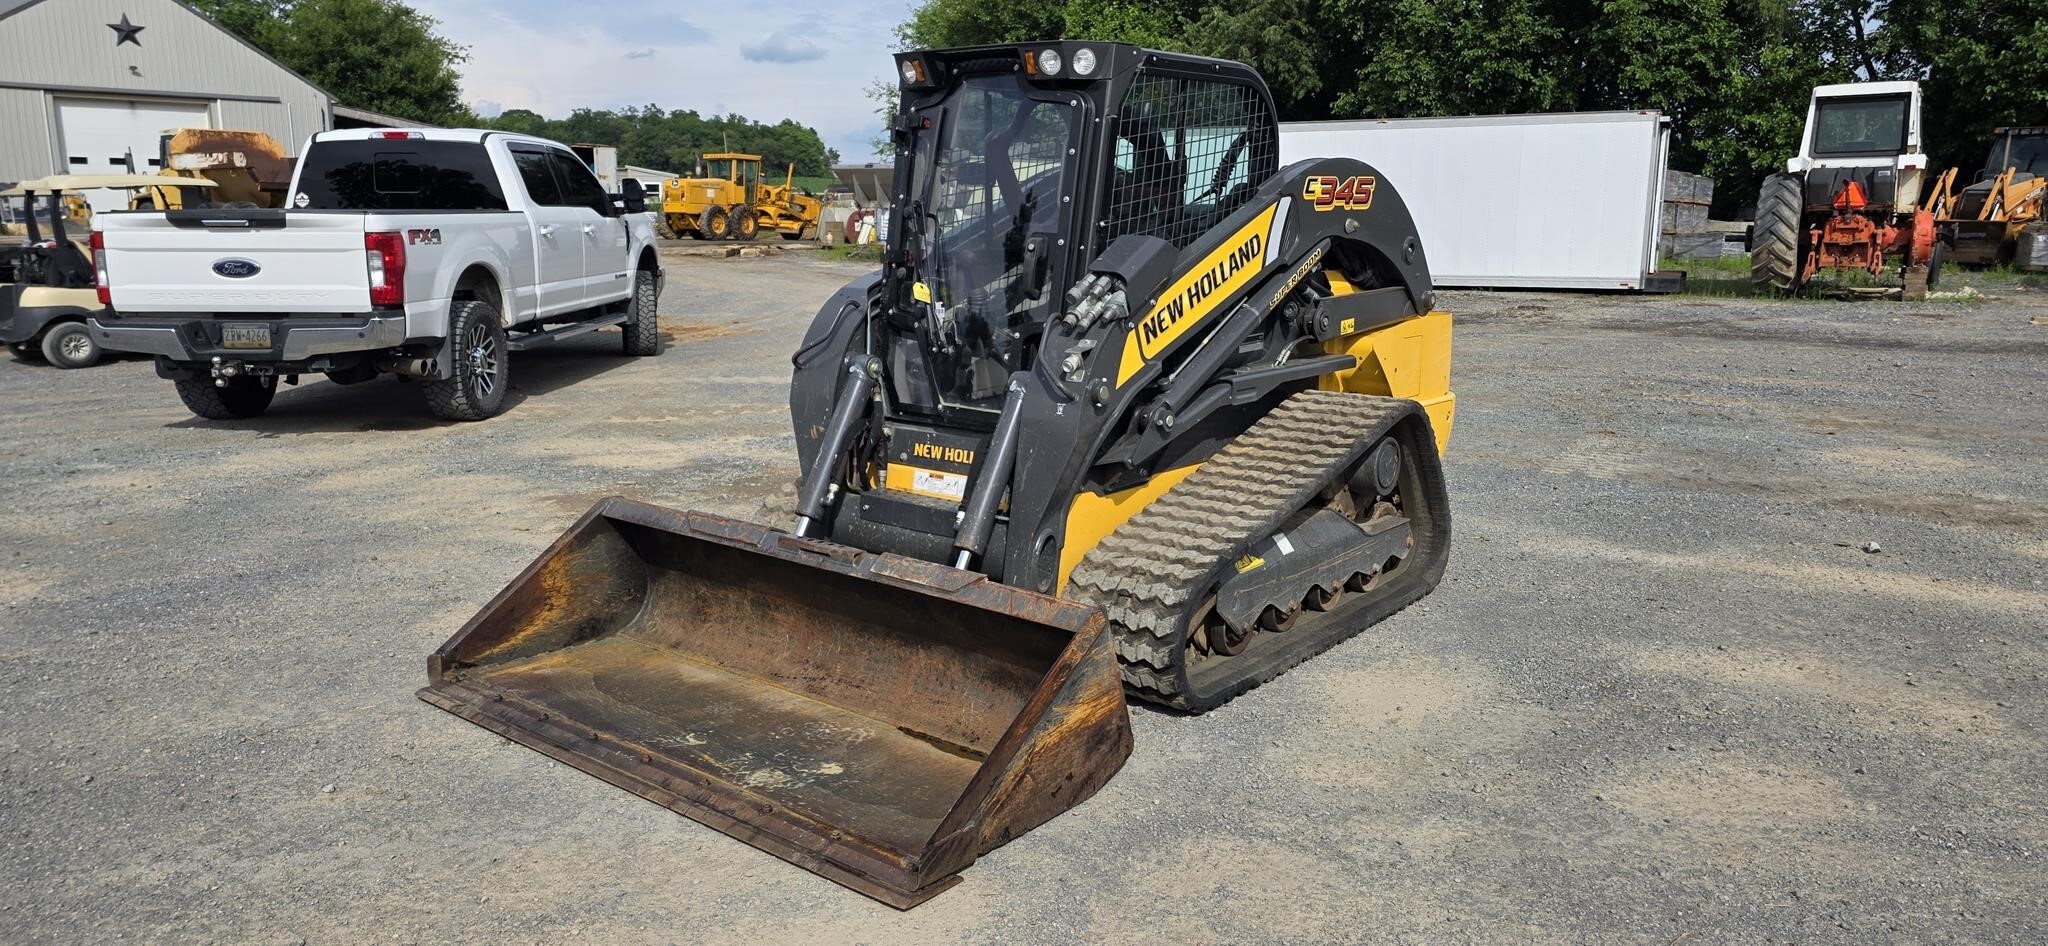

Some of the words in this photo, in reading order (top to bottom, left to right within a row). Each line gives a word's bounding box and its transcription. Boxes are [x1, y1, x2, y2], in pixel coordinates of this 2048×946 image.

[408, 228, 442, 246] FX4
[222, 262, 250, 275] Ford
[1268, 272, 1298, 310] SUPER
[1297, 247, 1322, 281] BOOM
[1142, 290, 1184, 346] NEW
[1186, 233, 1262, 309] HOLLAND
[913, 443, 943, 461] NEW
